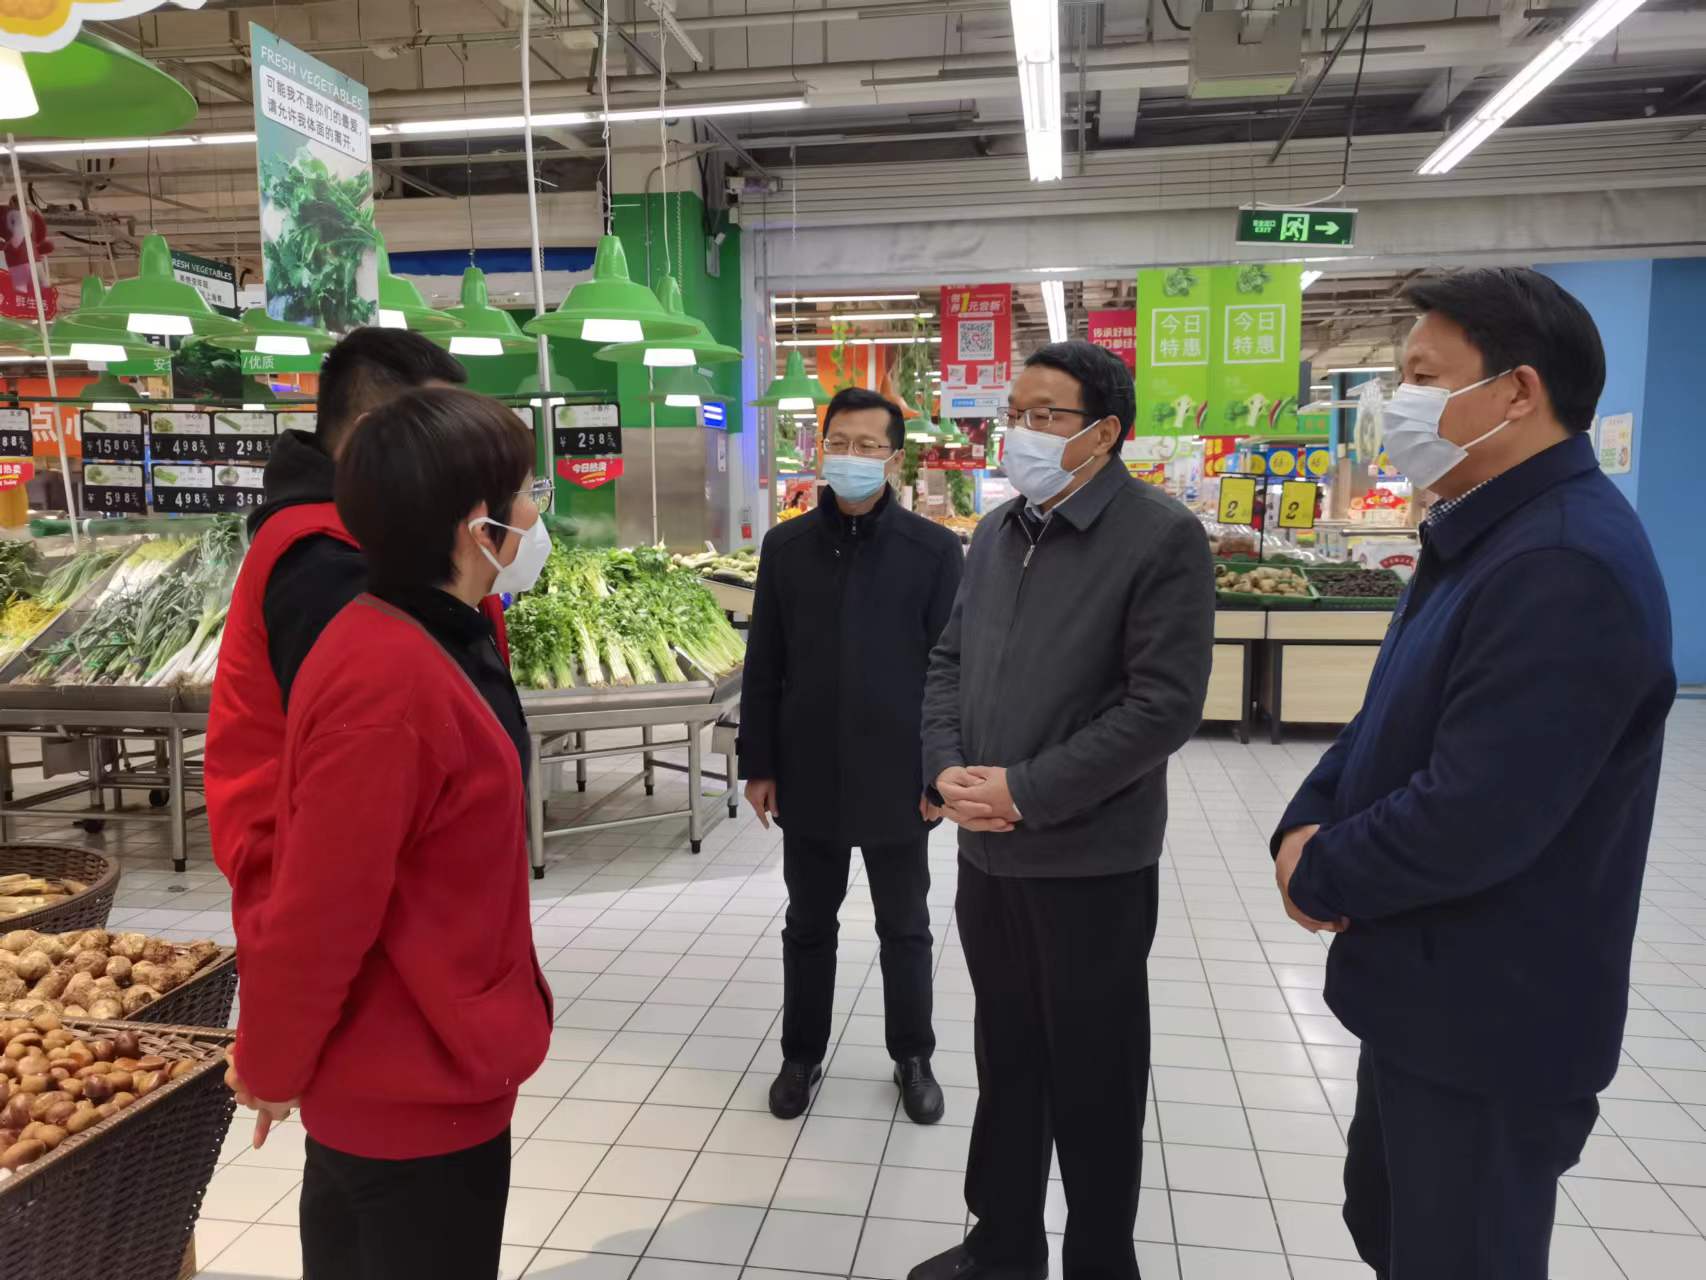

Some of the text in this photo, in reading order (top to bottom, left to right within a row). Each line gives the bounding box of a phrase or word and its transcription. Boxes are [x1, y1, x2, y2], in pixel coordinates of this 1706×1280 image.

[261, 46, 363, 108] FRESH VEGETABLES
[171, 258, 233, 280] RESH VEGETABLES
[1160, 313, 1200, 335] 今日
[1233, 311, 1275, 331] 今日
[1160, 338, 1201, 357] 特惠
[1232, 335, 1275, 354] 特惠
[0, 464, 21, 474] 热卖
[572, 462, 607, 473] 今日热卖
